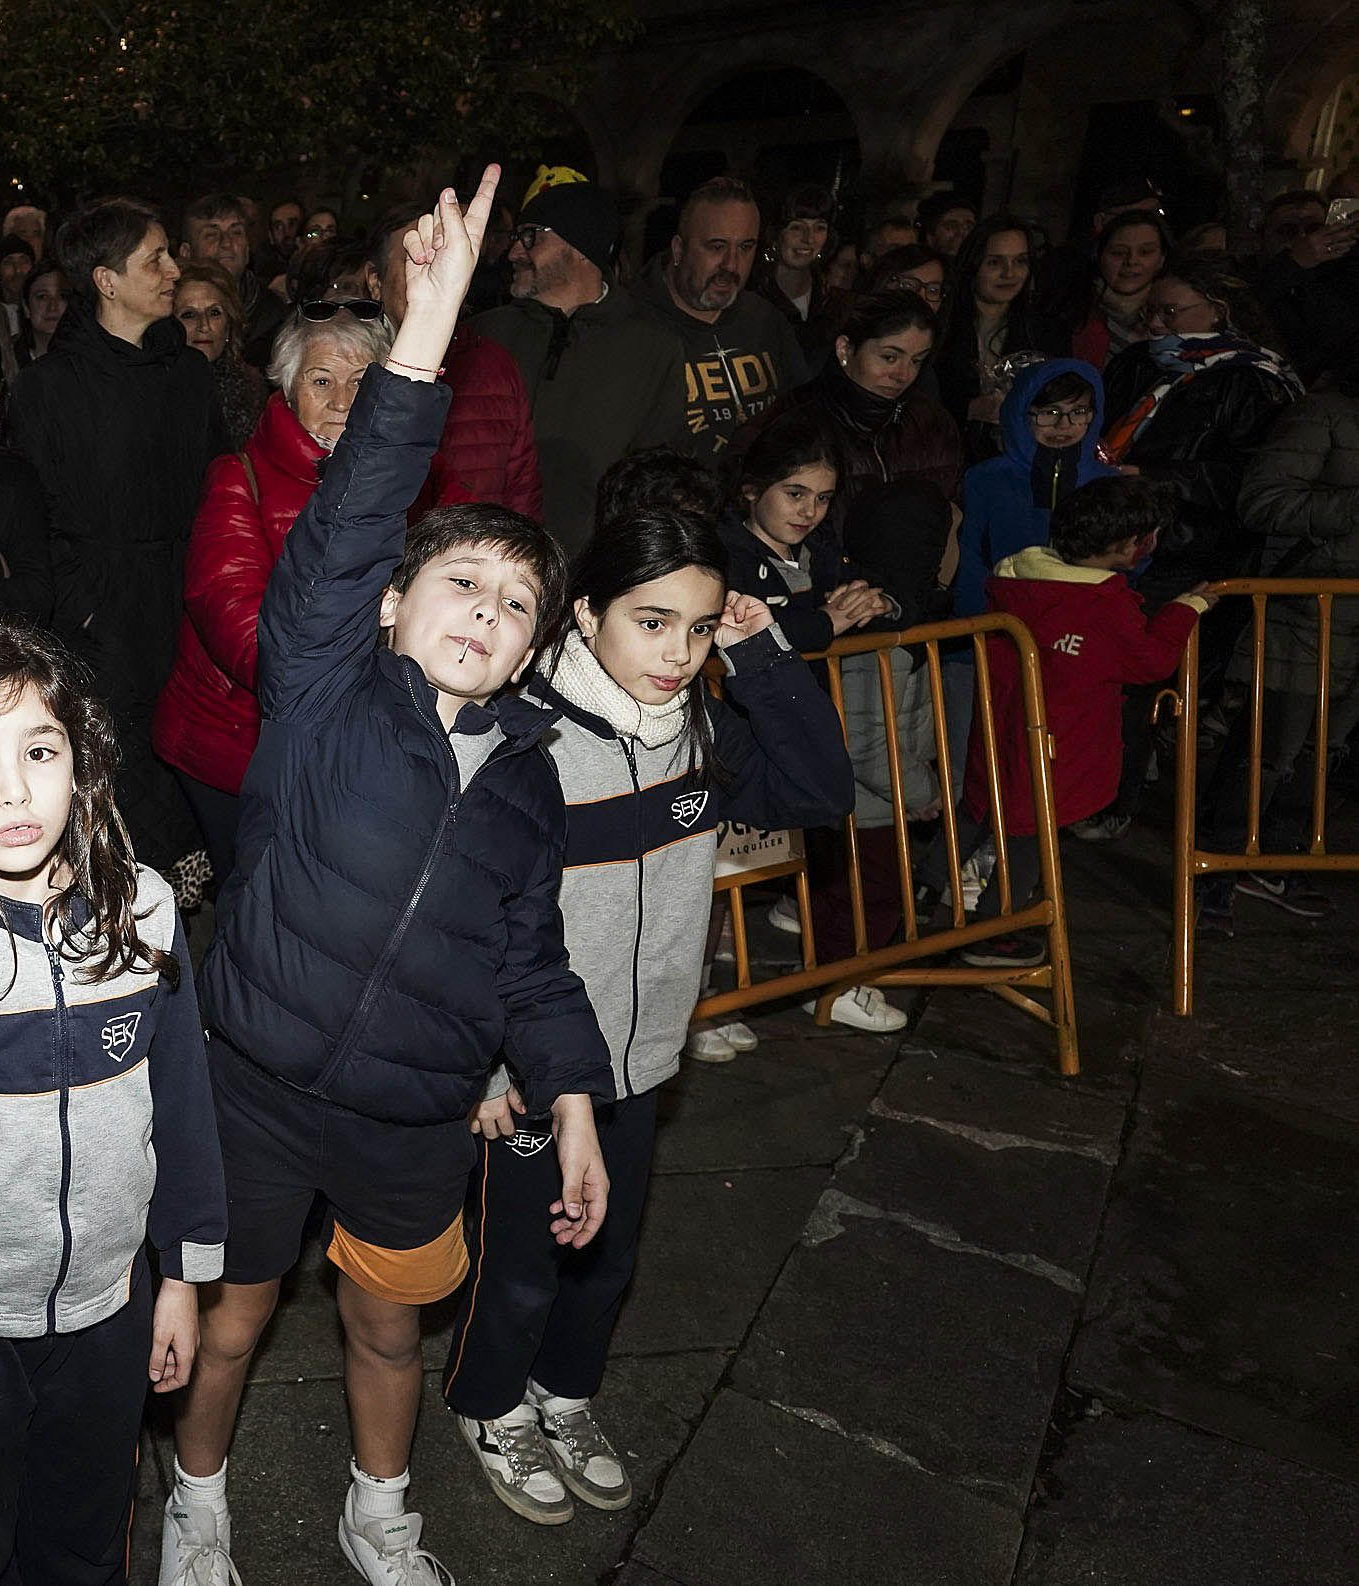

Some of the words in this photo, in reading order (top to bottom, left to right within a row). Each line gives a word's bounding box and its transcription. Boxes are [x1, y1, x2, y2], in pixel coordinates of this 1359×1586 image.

[685, 352, 778, 402] JEDI
[671, 796, 704, 820] SEK
[729, 837, 784, 857] ALQUILER
[101, 1019, 136, 1050] SEK
[505, 1133, 546, 1149] SEK
